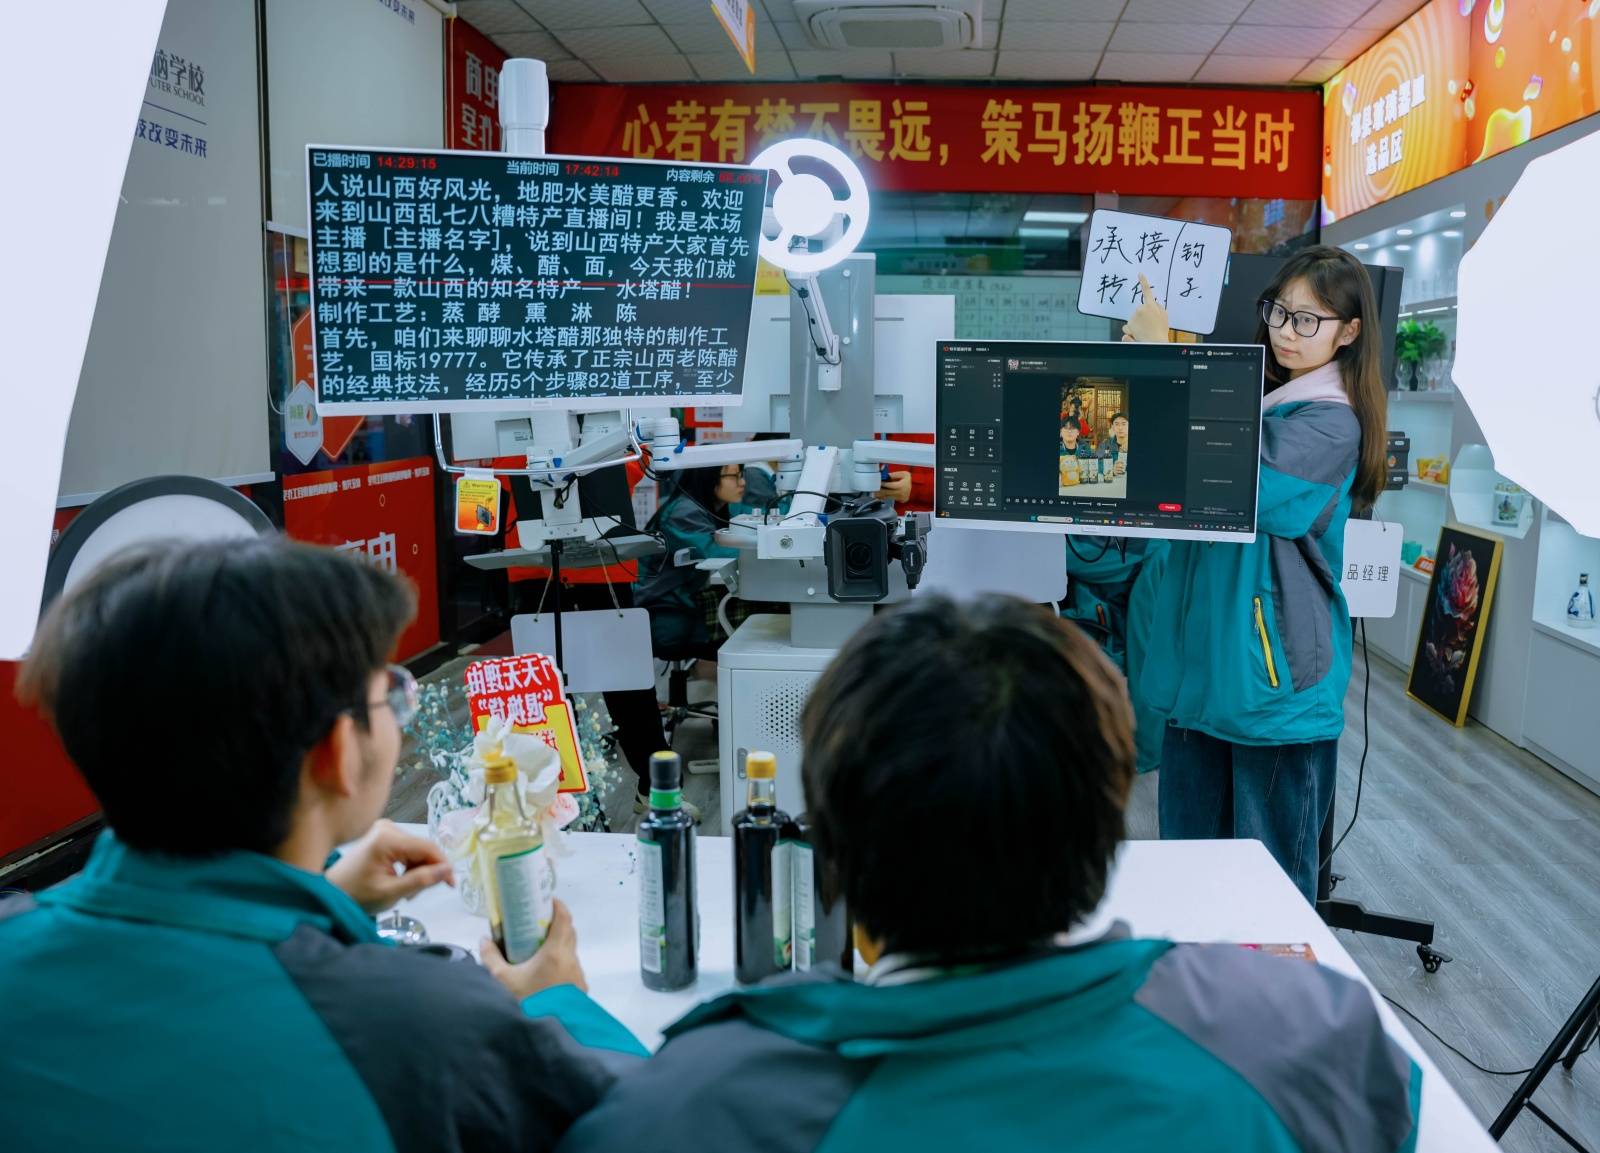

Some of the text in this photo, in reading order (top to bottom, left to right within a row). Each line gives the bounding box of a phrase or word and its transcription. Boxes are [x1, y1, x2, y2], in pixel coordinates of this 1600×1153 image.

[313, 152, 371, 169] 已播时间
[506, 161, 559, 177] 当前时间
[666, 169, 715, 184] 内容剩余
[1092, 225, 1169, 264] 承接
